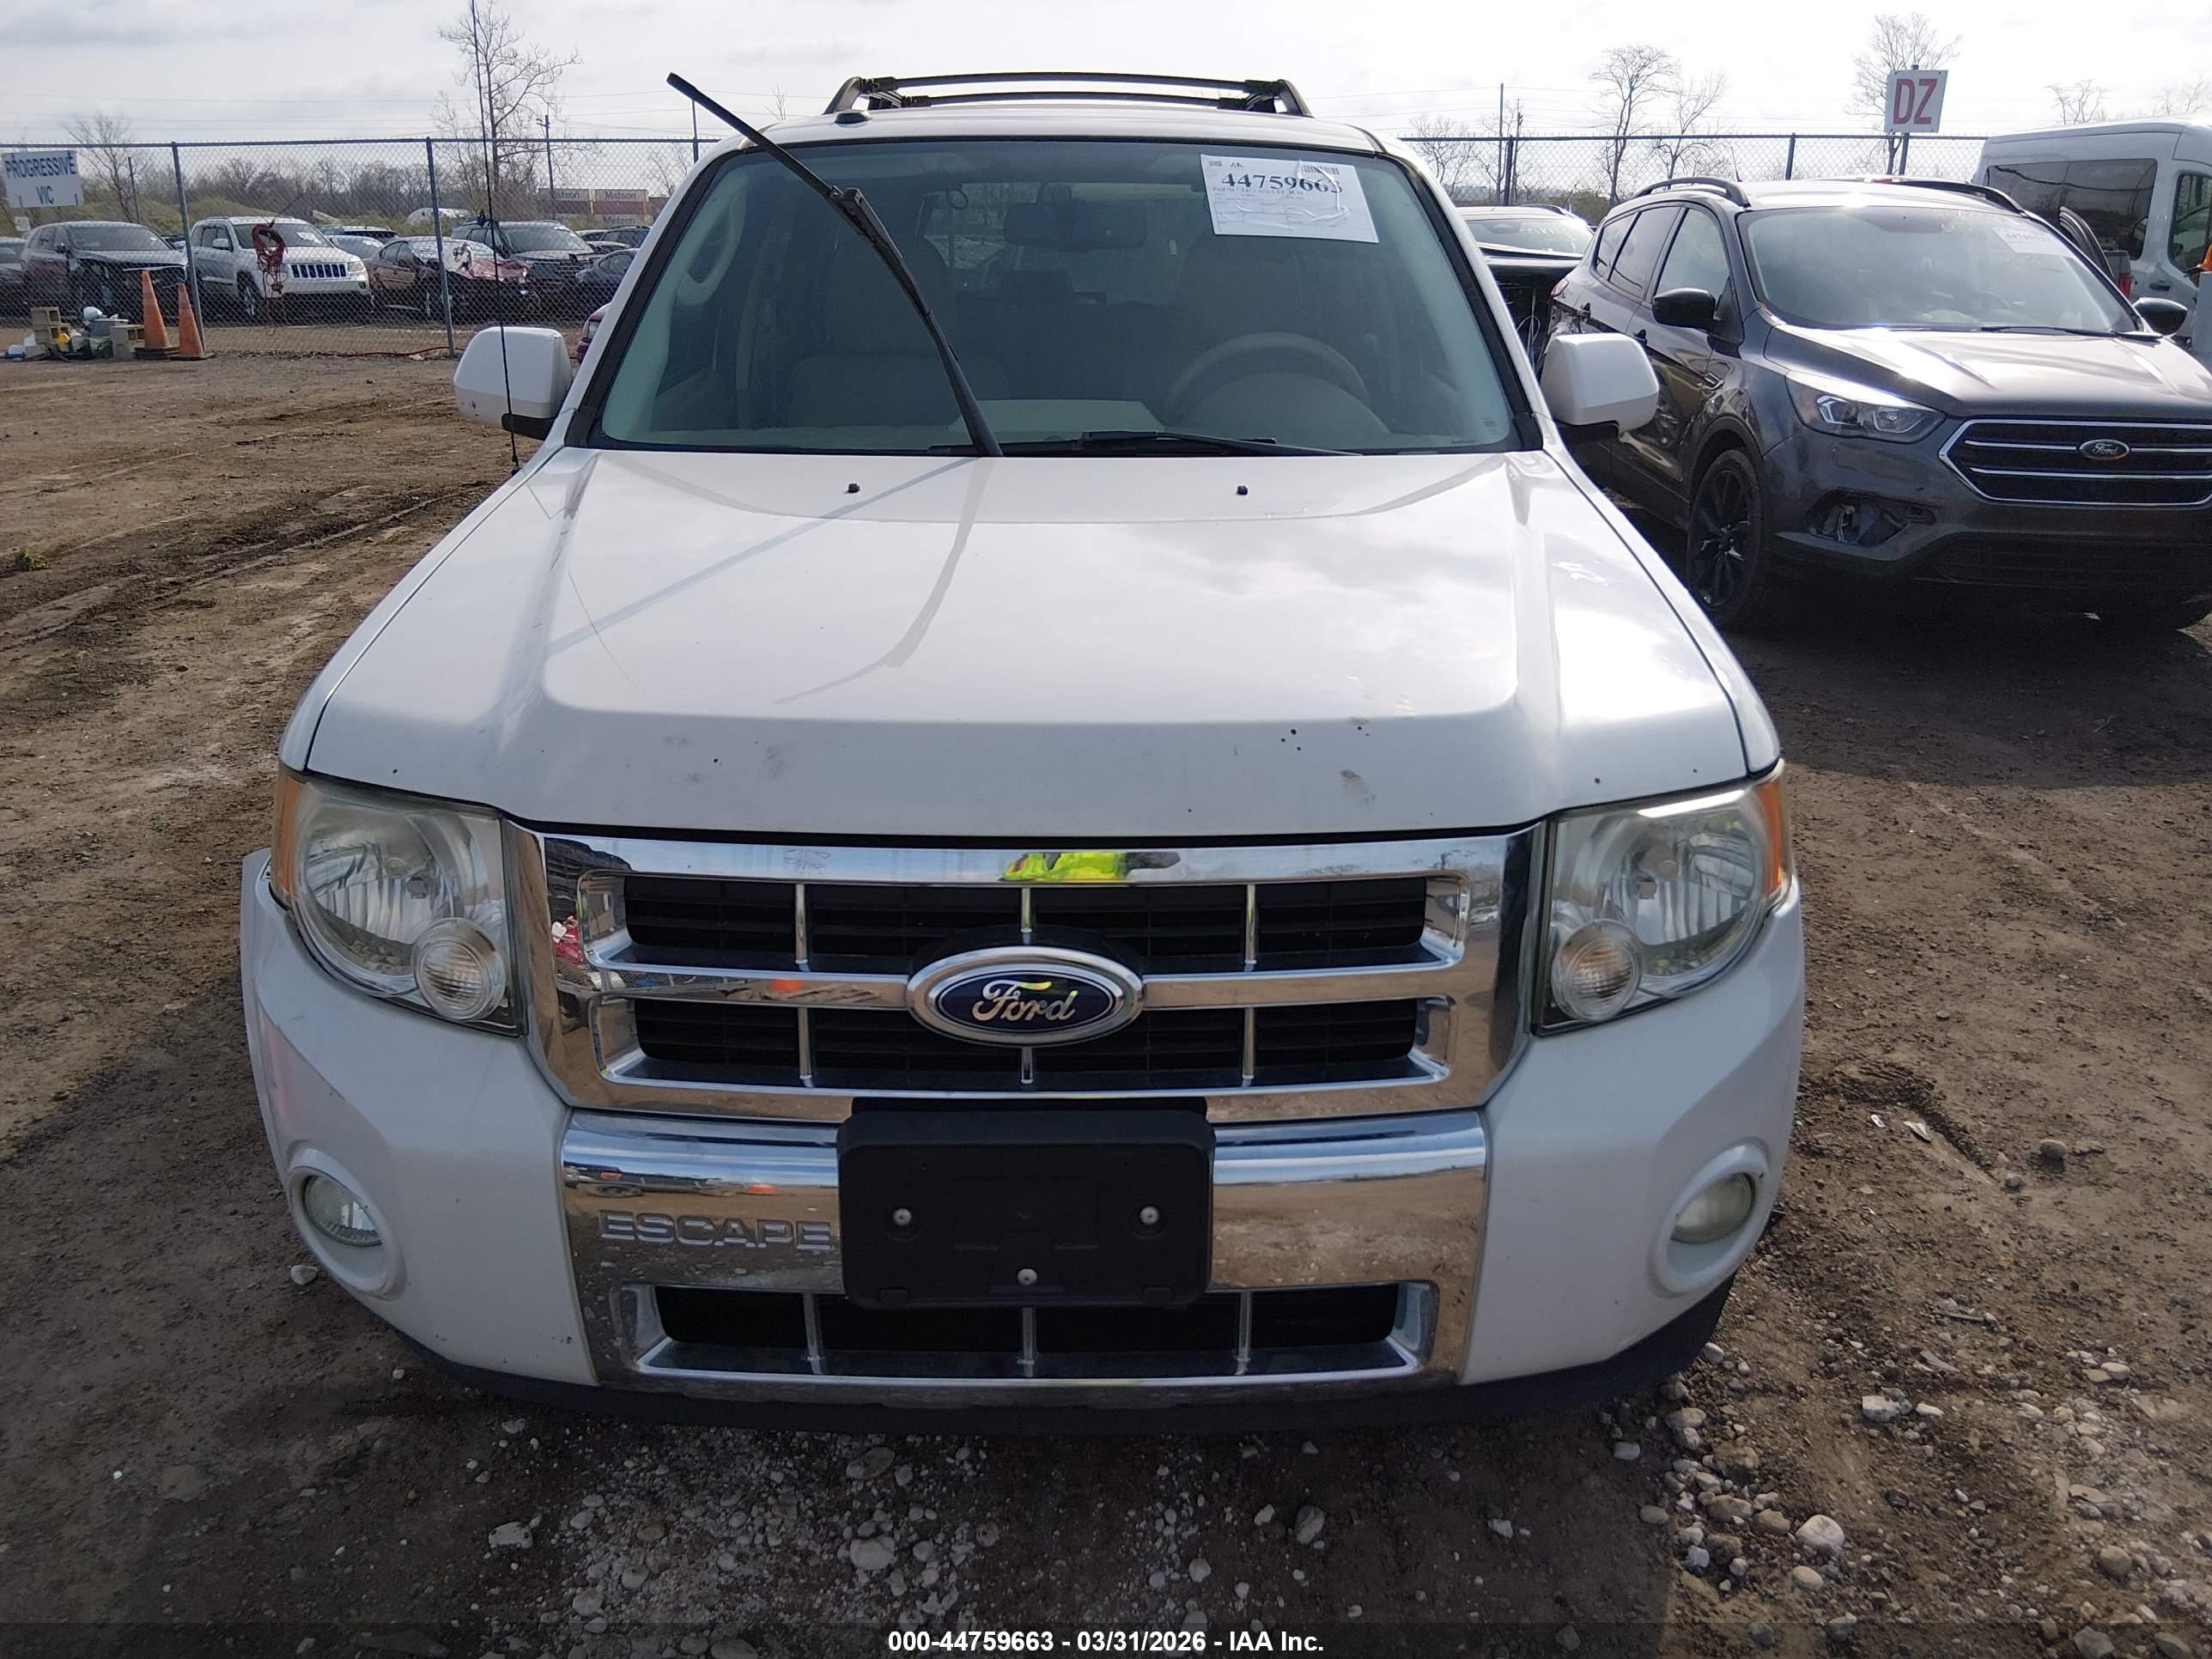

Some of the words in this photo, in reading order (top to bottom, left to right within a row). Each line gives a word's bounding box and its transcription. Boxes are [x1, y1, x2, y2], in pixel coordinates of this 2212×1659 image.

[1893, 78, 1937, 125] DZ
[5, 156, 76, 179] PROGRESSIVE
[605, 191, 636, 200] Matson
[2092, 442, 2119, 454] Ford
[972, 980, 1079, 1021] Ford
[599, 1210, 832, 1251] ESCAPE
